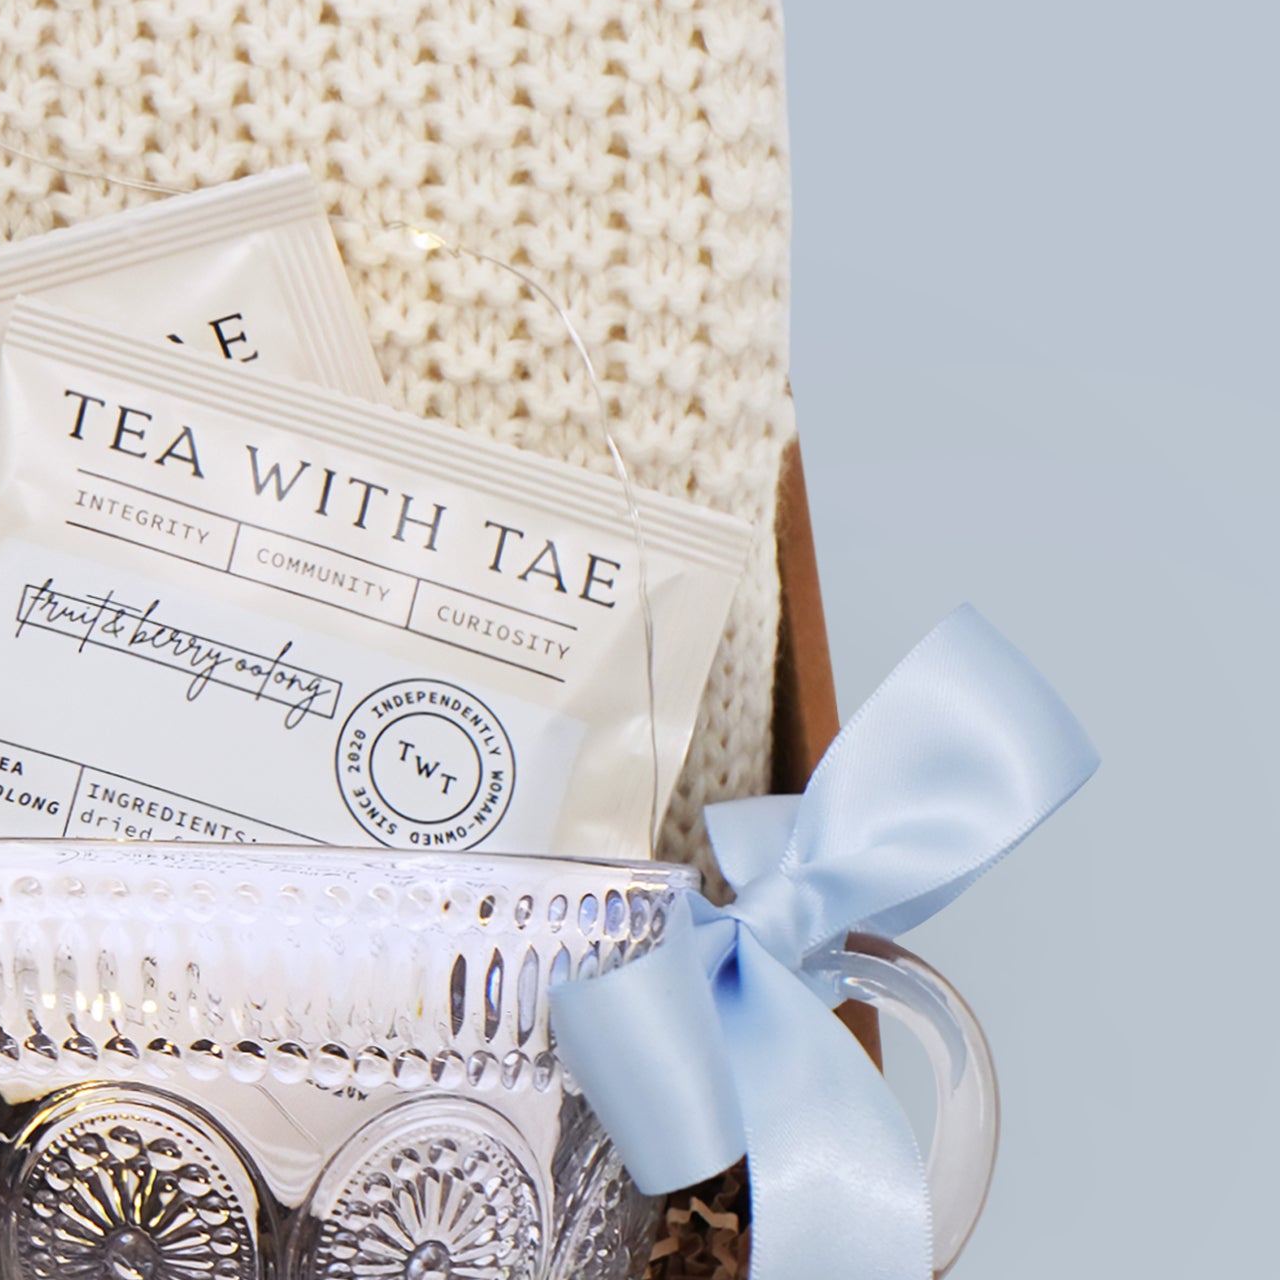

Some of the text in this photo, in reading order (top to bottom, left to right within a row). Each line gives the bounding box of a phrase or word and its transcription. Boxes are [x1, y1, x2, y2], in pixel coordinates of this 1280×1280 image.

[64, 389, 622, 609] TEA WITH TAE
[75, 488, 572, 661] INTEGRITY COMMUNITY CURIOSITY
[234, 640, 332, 730] oolong
[79, 808, 152, 841] dried
[347, 690, 505, 847] INDEPENDENTLY WOMAN-OWNED SINCE 2020
[398, 739, 458, 795] TWT
